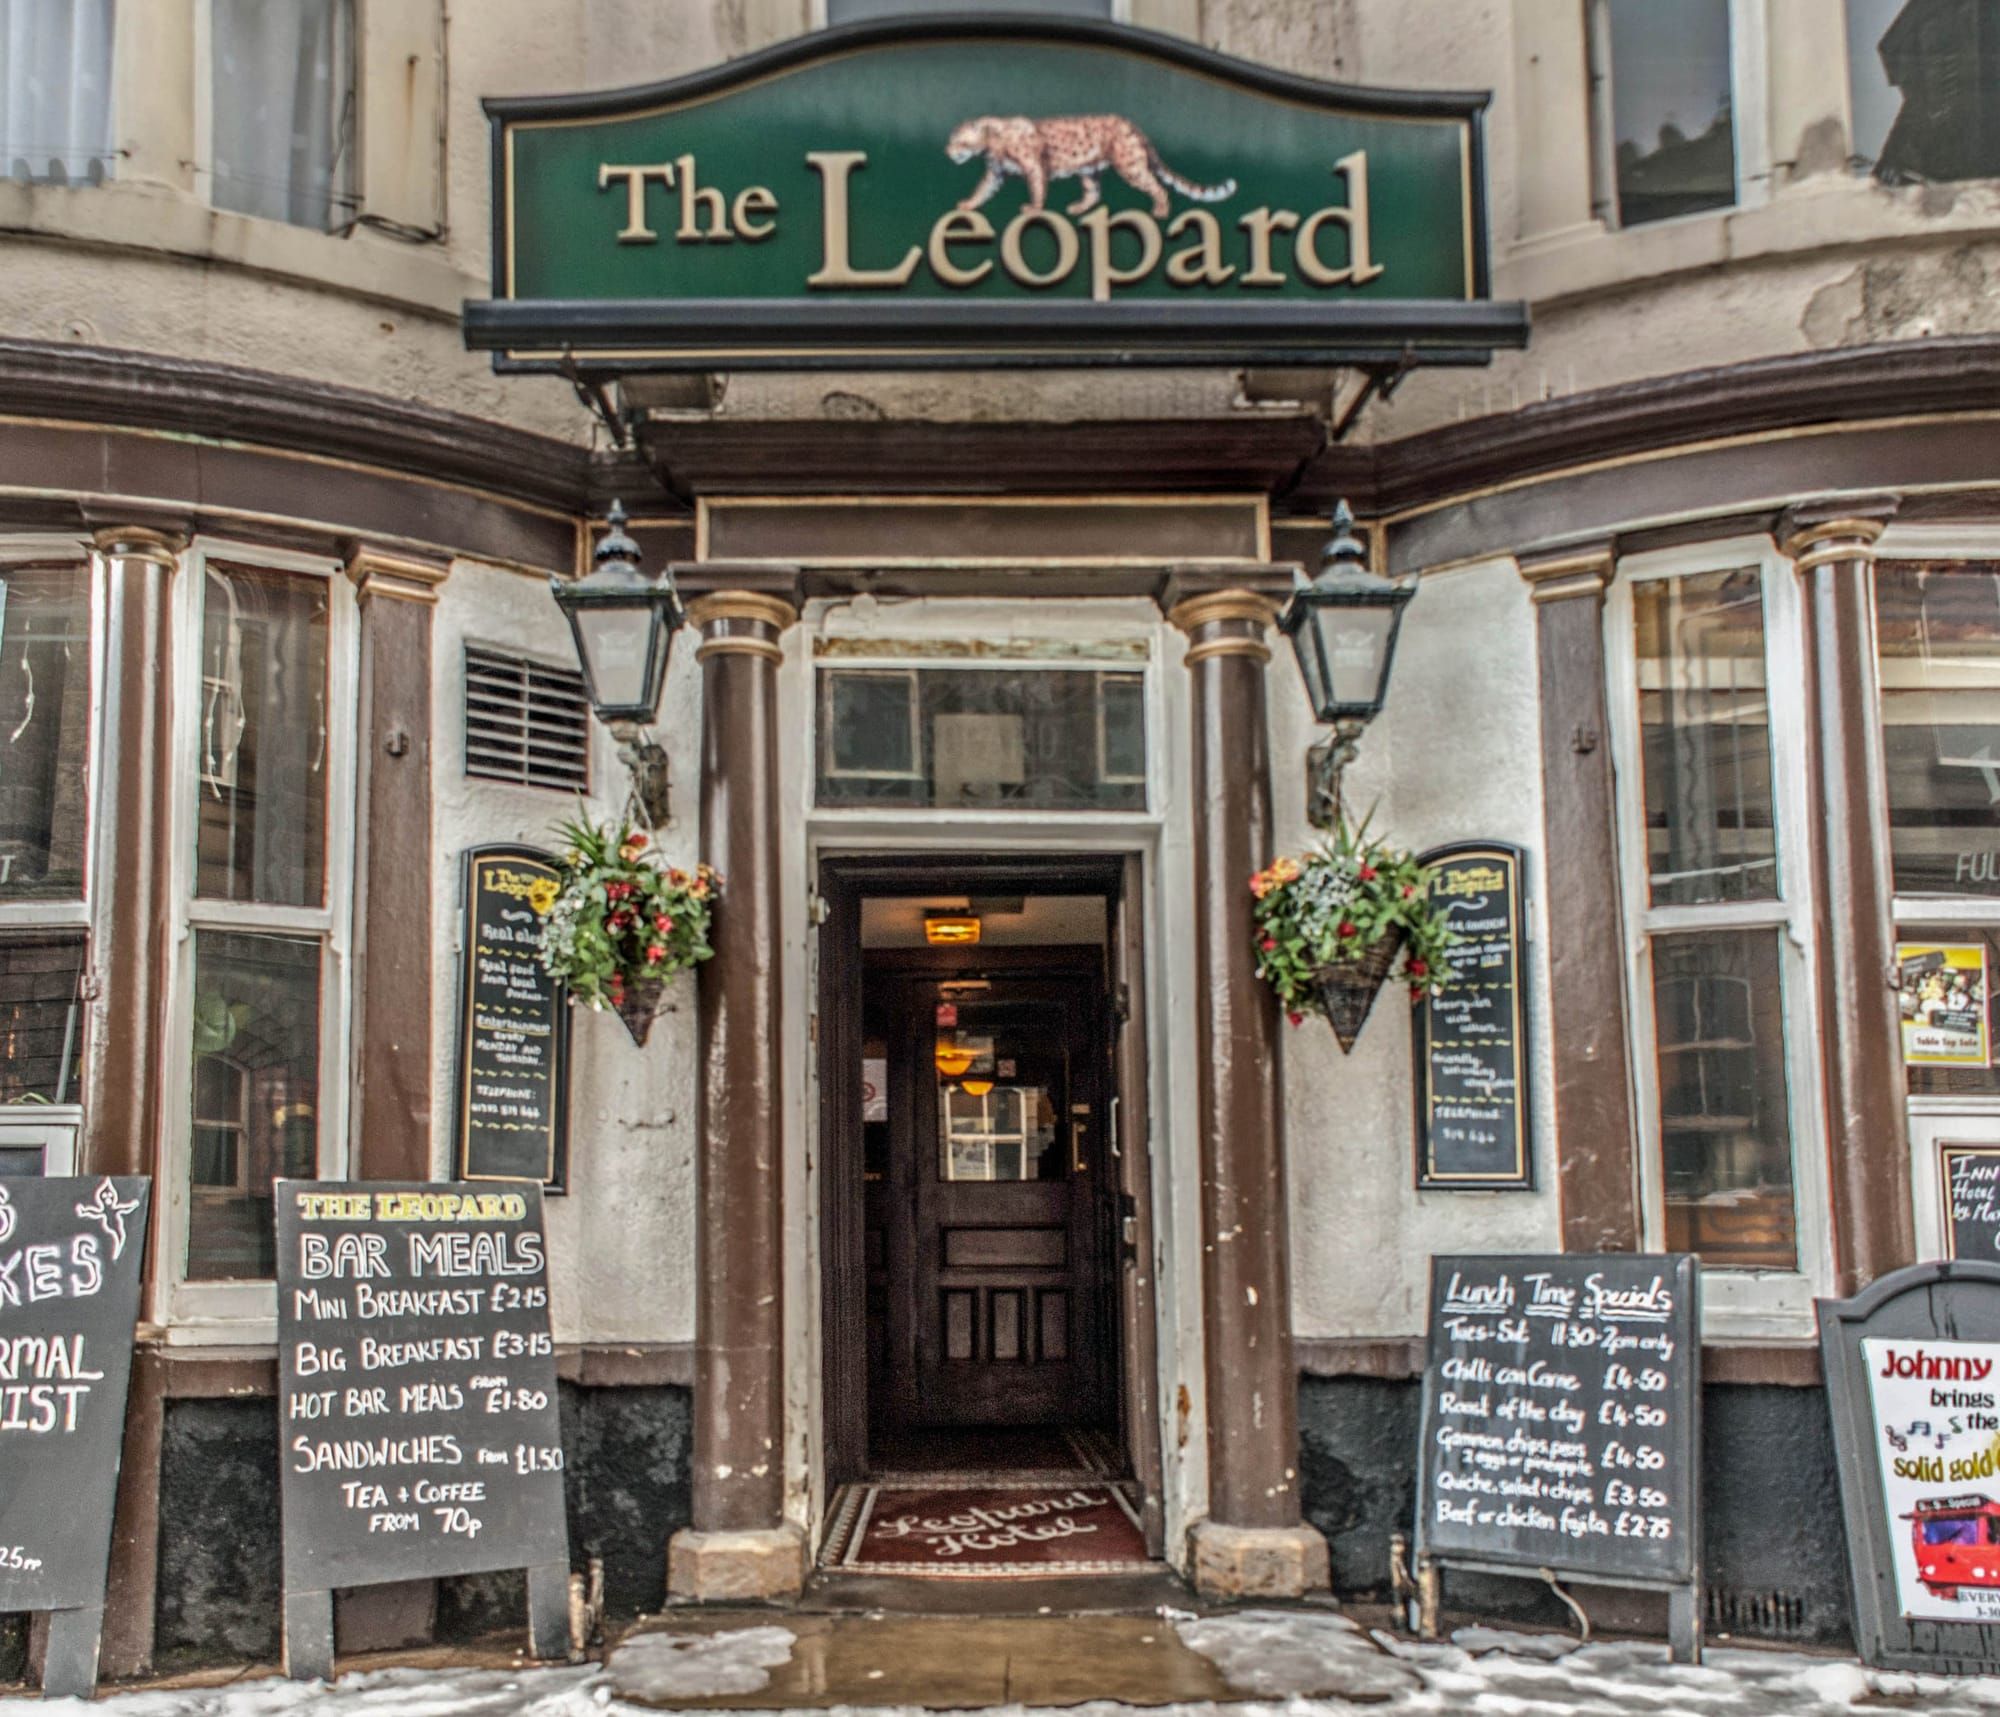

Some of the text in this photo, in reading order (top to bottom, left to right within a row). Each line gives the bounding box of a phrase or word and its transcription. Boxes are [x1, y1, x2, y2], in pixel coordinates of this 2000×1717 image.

[599, 149, 1385, 301] The Leopard
[297, 1192, 528, 1222] THE LEOPARD
[1951, 1179, 1996, 1201] Hotel
[300, 1230, 546, 1280] BAR MEALS
[355, 1282, 486, 1320] BREAKFAST
[1446, 1271, 1674, 1316] Lunch Time Specials
[360, 1335, 485, 1371] BREAKFAST
[1880, 1349, 1993, 1381] Johnny
[1441, 1357, 1492, 1383] Chilli
[1495, 1366, 1527, 1386] con
[289, 1391, 338, 1420] HOT
[344, 1386, 391, 1417] BAR
[400, 1383, 464, 1414] MEALS
[1495, 1396, 1519, 1421] of
[1518, 1397, 1547, 1421] the
[1549, 1398, 1587, 1434] day
[1930, 1387, 1996, 1409] brings
[1967, 1412, 1999, 1430] the
[293, 1434, 463, 1473] SANDWICHES
[1893, 1448, 1993, 1483] solid gold
[341, 1480, 389, 1509] TEA
[414, 1479, 487, 1504] COFFEE
[368, 1507, 483, 1539] FROM 70p
[873, 1490, 1108, 1538] Leopard
[1436, 1499, 1479, 1526] Beef
[1477, 1510, 1497, 1523] or
[926, 1516, 1099, 1556] Hotel
